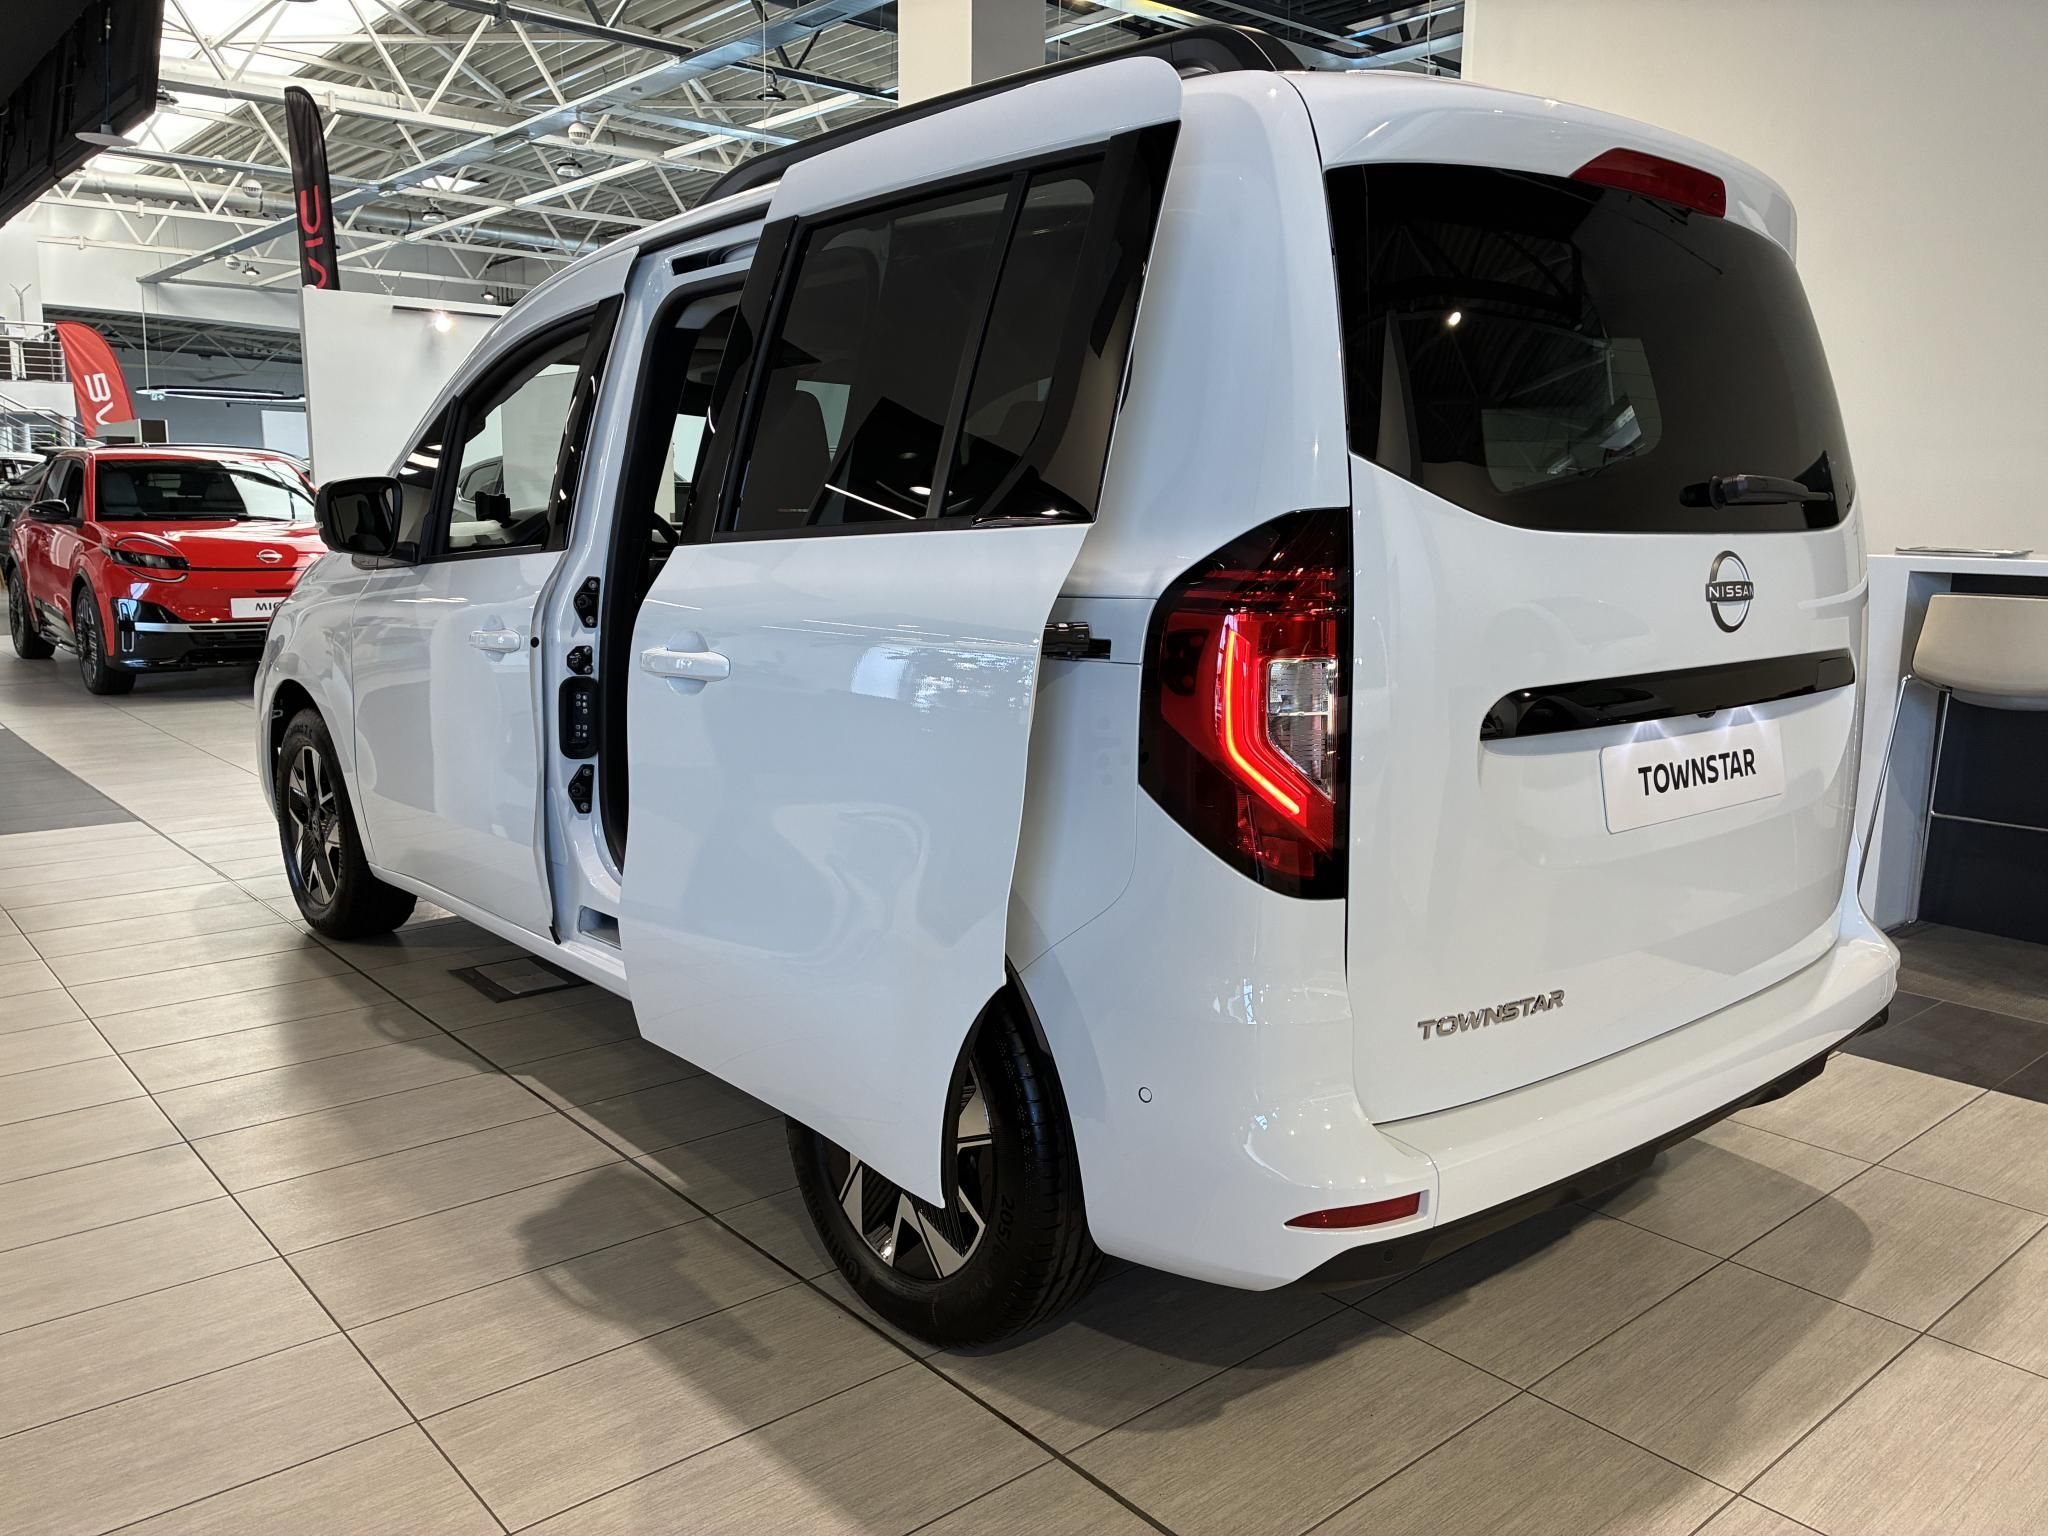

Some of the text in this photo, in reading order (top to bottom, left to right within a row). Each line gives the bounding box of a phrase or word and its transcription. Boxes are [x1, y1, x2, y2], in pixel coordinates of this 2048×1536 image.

[1708, 585, 1754, 598] NISSAN
[1638, 748, 1757, 796] TOWNSTAR
[1417, 989, 1565, 1040] TOWNSTAR
